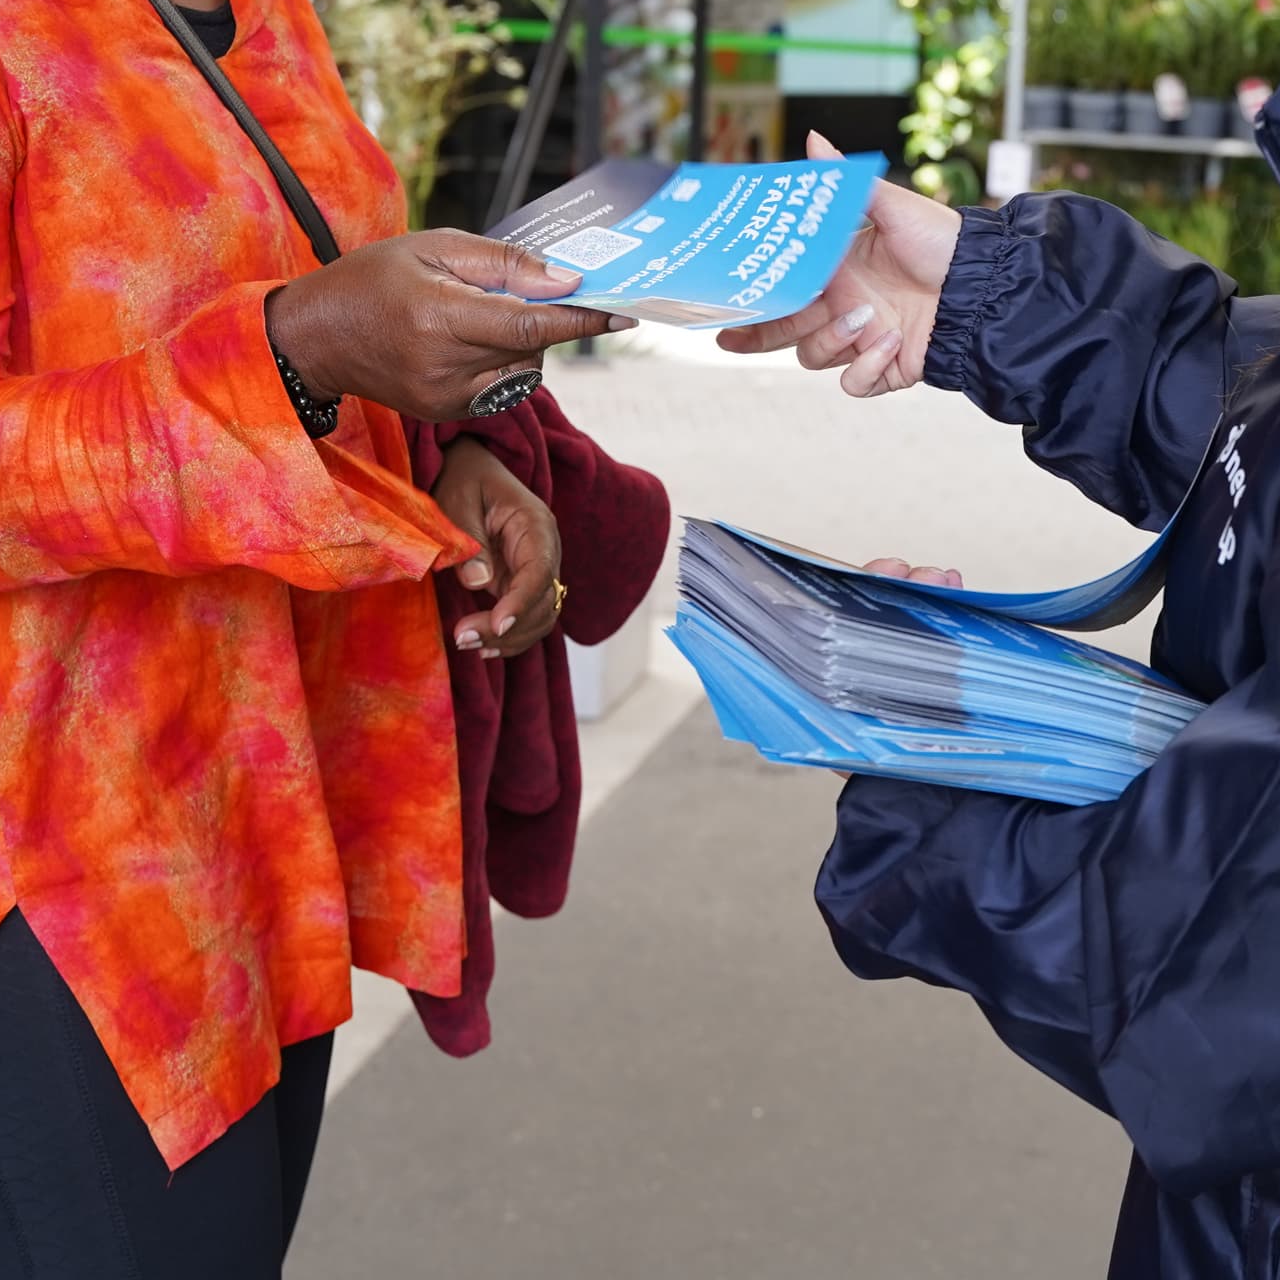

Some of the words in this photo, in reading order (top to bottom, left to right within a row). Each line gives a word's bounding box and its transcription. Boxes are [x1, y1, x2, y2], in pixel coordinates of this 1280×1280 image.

[722, 175, 763, 225] Trouver
[786, 170, 817, 206] PU
[797, 168, 844, 237] VOUS
[670, 239, 692, 256] sur
[705, 226, 724, 242] un
[728, 211, 796, 281] MIEUX
[640, 240, 708, 289] prestataire
[728, 238, 805, 307] AURIEZ
